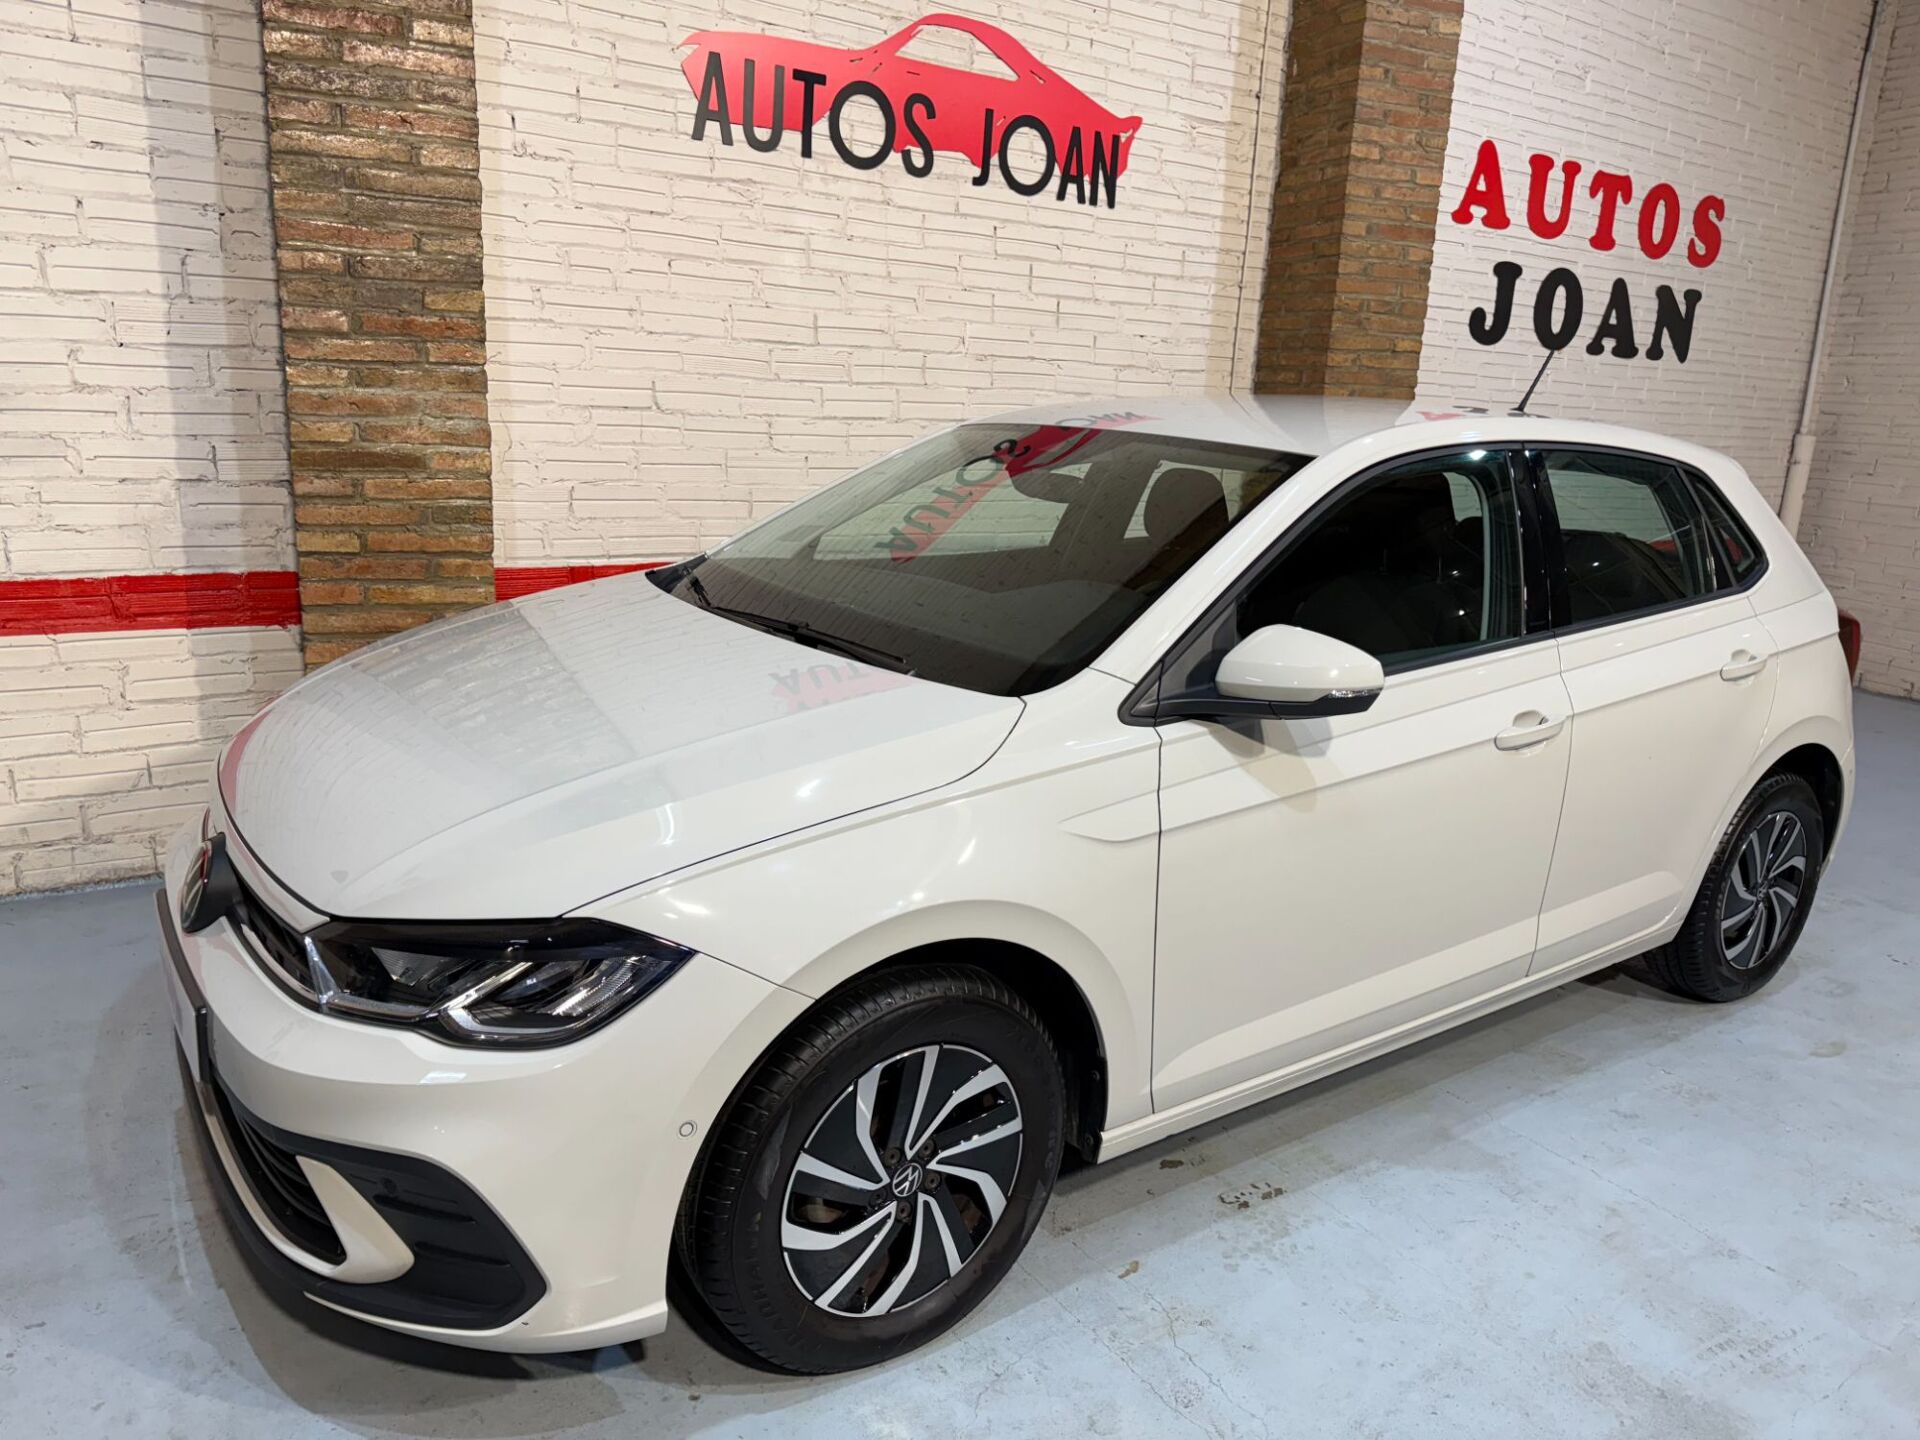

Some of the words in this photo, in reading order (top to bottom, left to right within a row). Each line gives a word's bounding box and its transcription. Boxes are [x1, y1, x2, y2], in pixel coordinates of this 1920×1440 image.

[691, 51, 936, 178] AUTOS
[972, 108, 1120, 209] JOAN
[1451, 139, 1725, 268] AUTOS
[1469, 261, 1702, 363] JOAN
